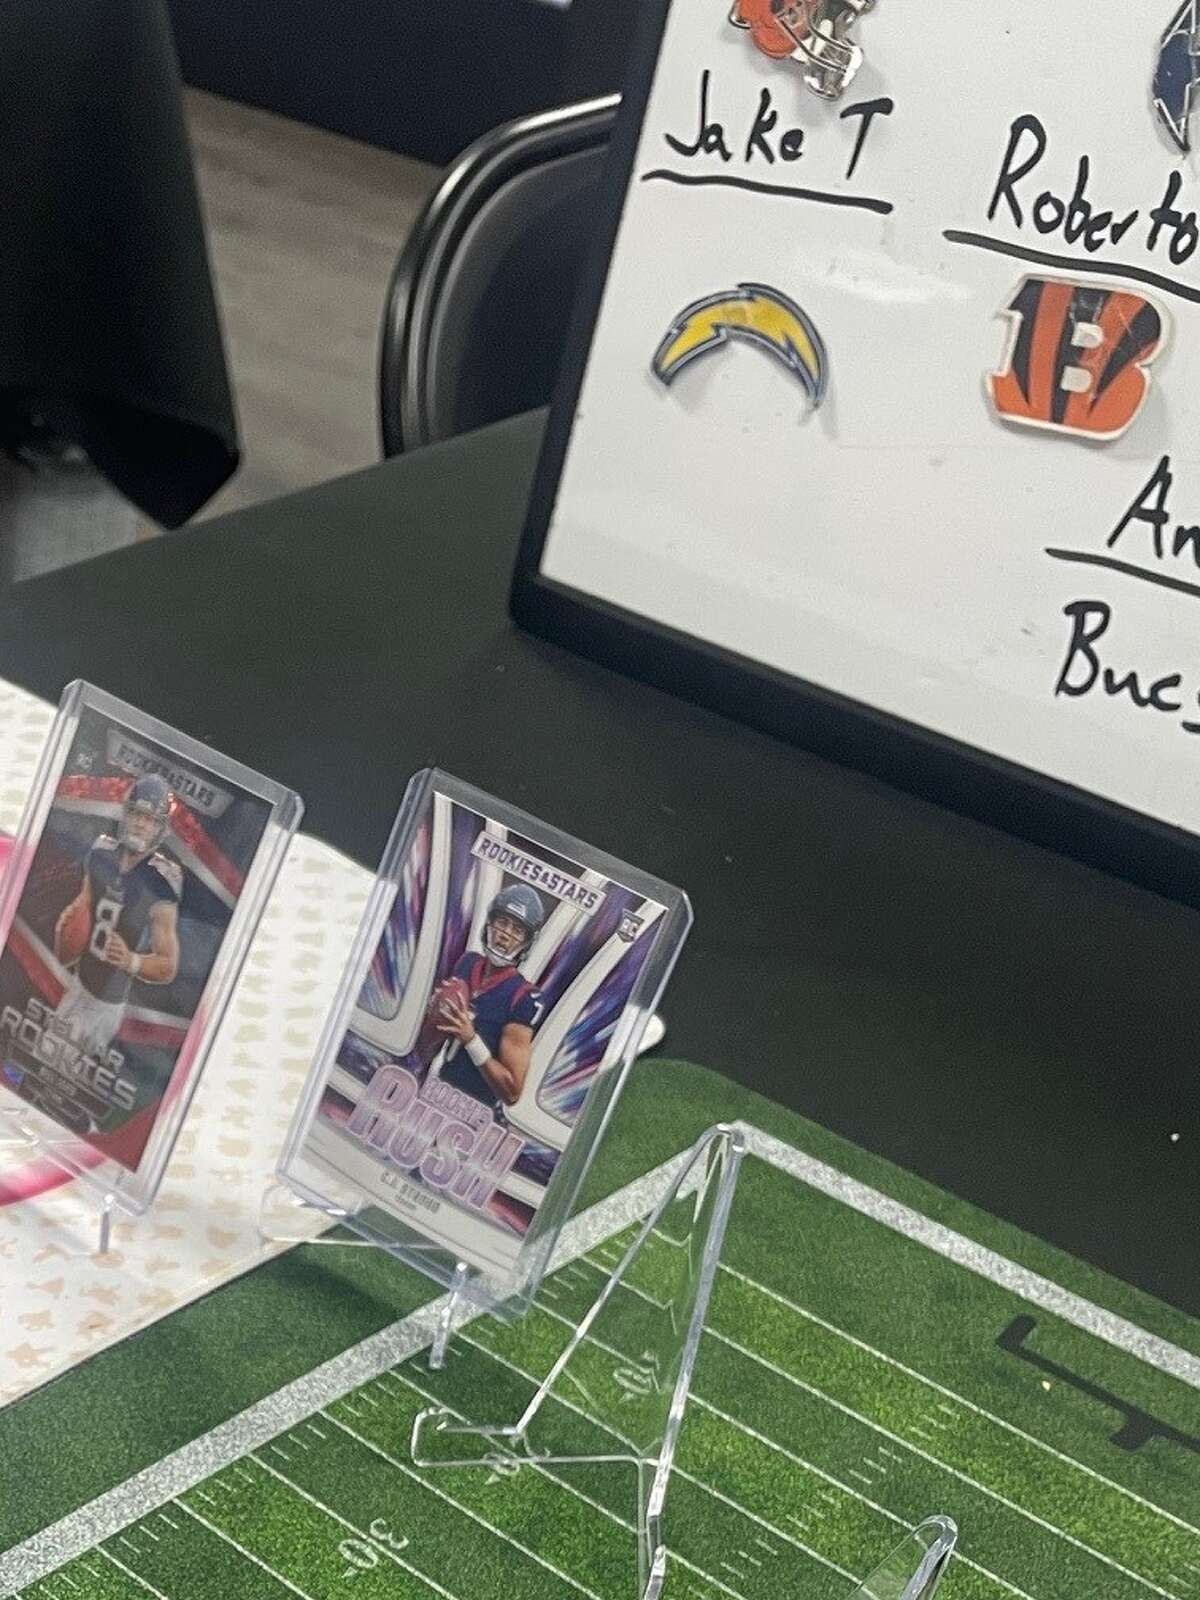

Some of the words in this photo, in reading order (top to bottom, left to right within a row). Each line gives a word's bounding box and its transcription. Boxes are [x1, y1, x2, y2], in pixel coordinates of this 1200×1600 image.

[666, 70, 803, 164] Jake
[841, 98, 894, 181] T
[987, 114, 1199, 265] Roberto
[1055, 600, 1200, 712] Buc
[478, 837, 599, 910] ROOKIES&STARS
